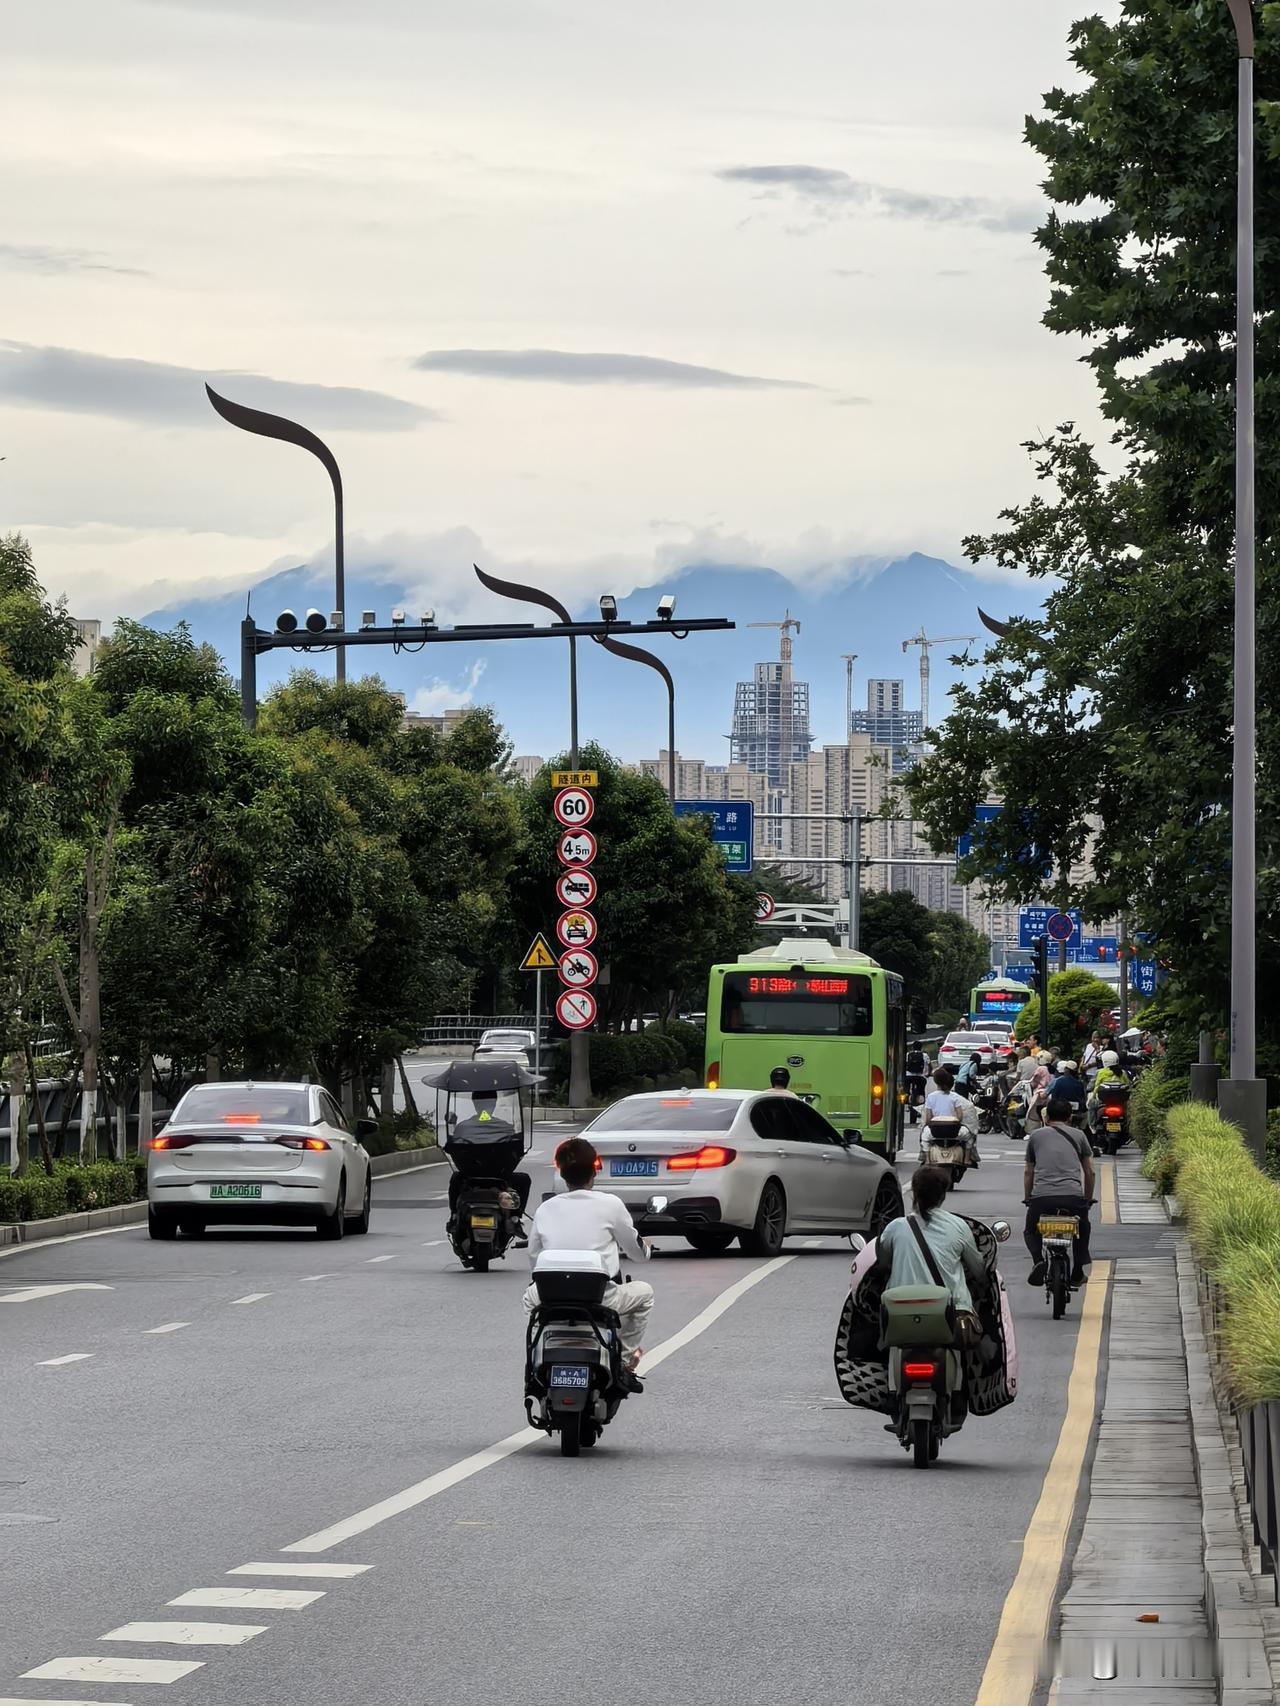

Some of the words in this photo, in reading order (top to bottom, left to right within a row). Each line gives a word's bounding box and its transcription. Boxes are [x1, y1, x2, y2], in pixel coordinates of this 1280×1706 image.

[558, 773, 591, 785] 隧道内
[562, 799, 586, 815] 60
[1140, 961, 1154, 992] 街坊
